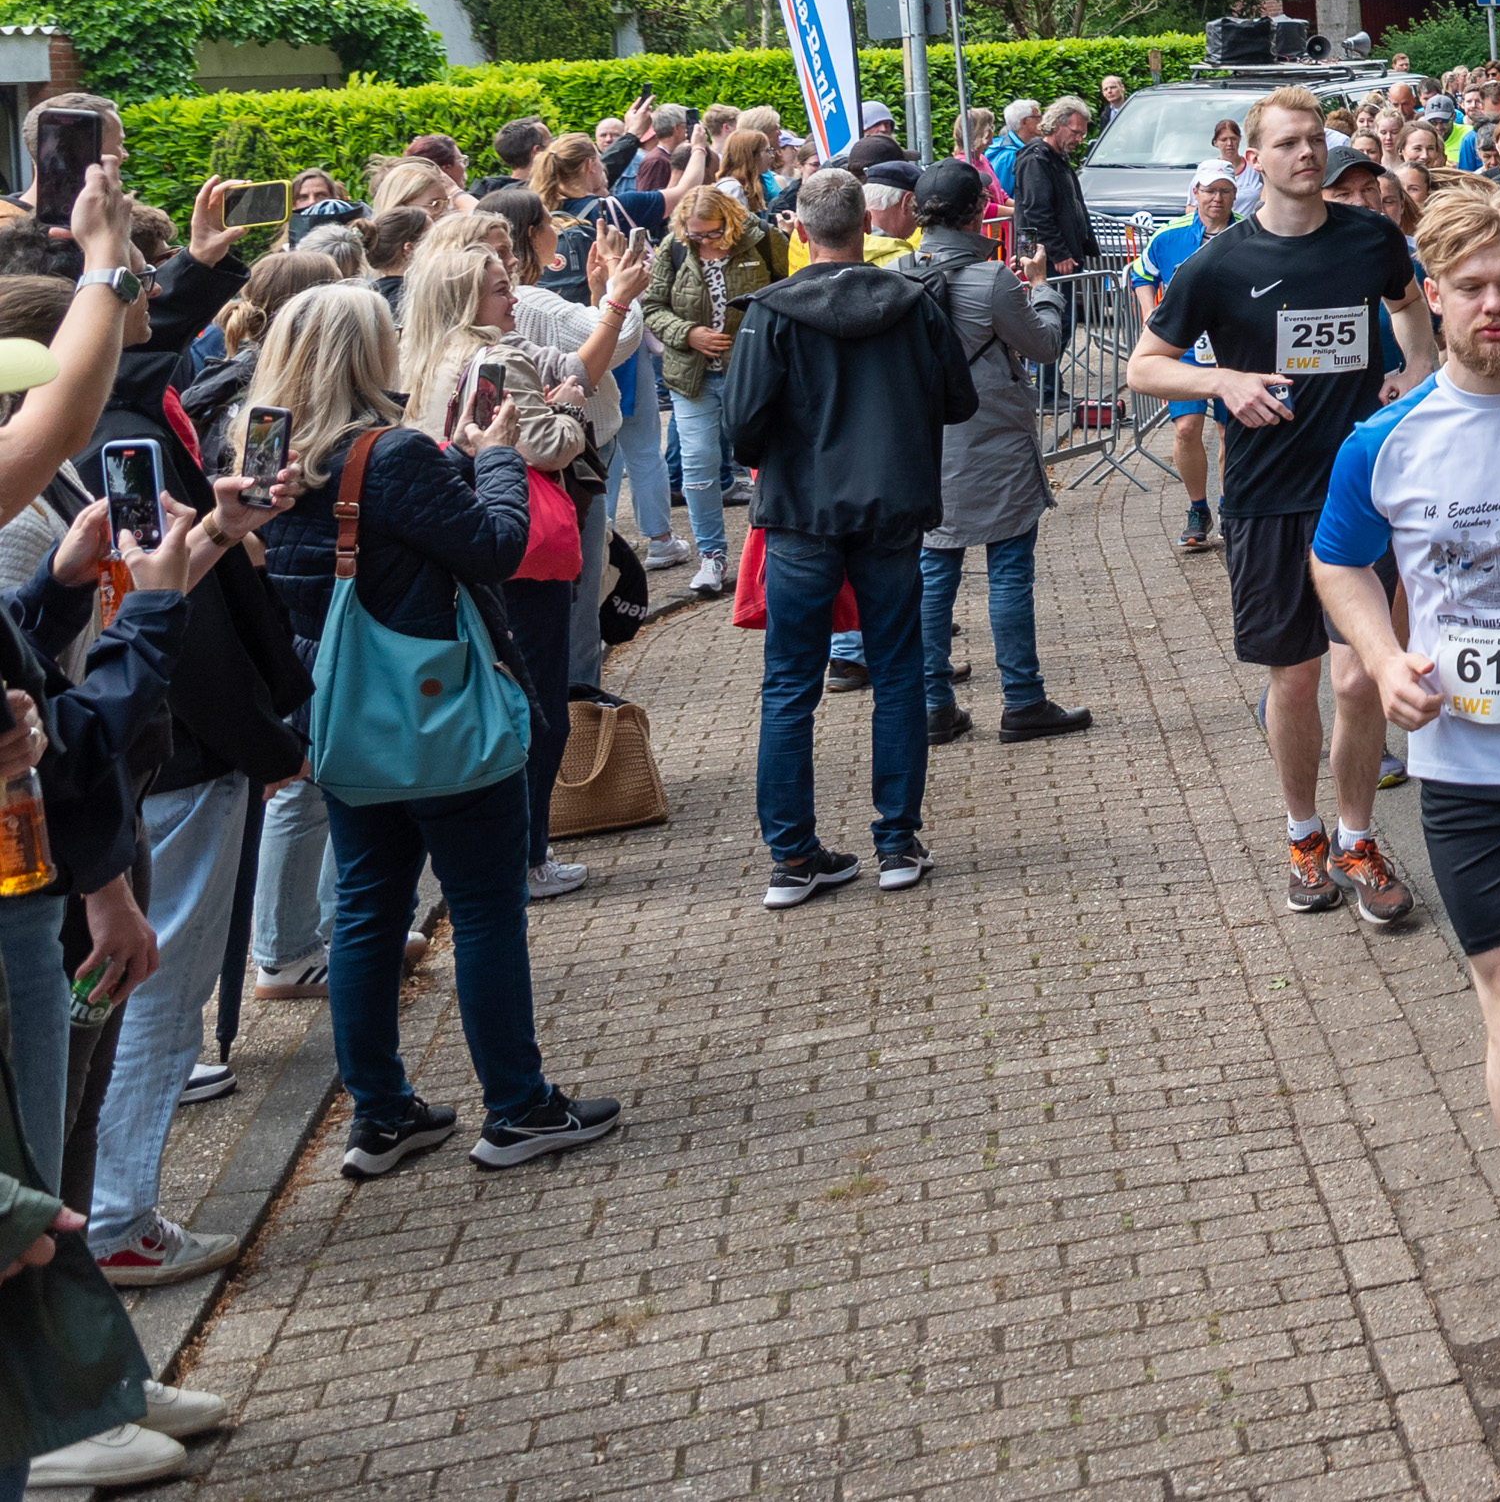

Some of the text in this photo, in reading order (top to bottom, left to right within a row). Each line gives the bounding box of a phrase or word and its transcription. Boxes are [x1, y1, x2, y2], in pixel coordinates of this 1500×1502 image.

[1324, 312, 1364, 320] Brunnenlauf
[1291, 320, 1356, 348] 255
[1286, 357, 1320, 368] EWE
[1334, 354, 1361, 365] bruns
[1424, 505, 1439, 519] 14.
[1452, 518, 1491, 530] Oldenburg
[1448, 635, 1494, 645] Everstener
[1453, 696, 1492, 715] EWE
